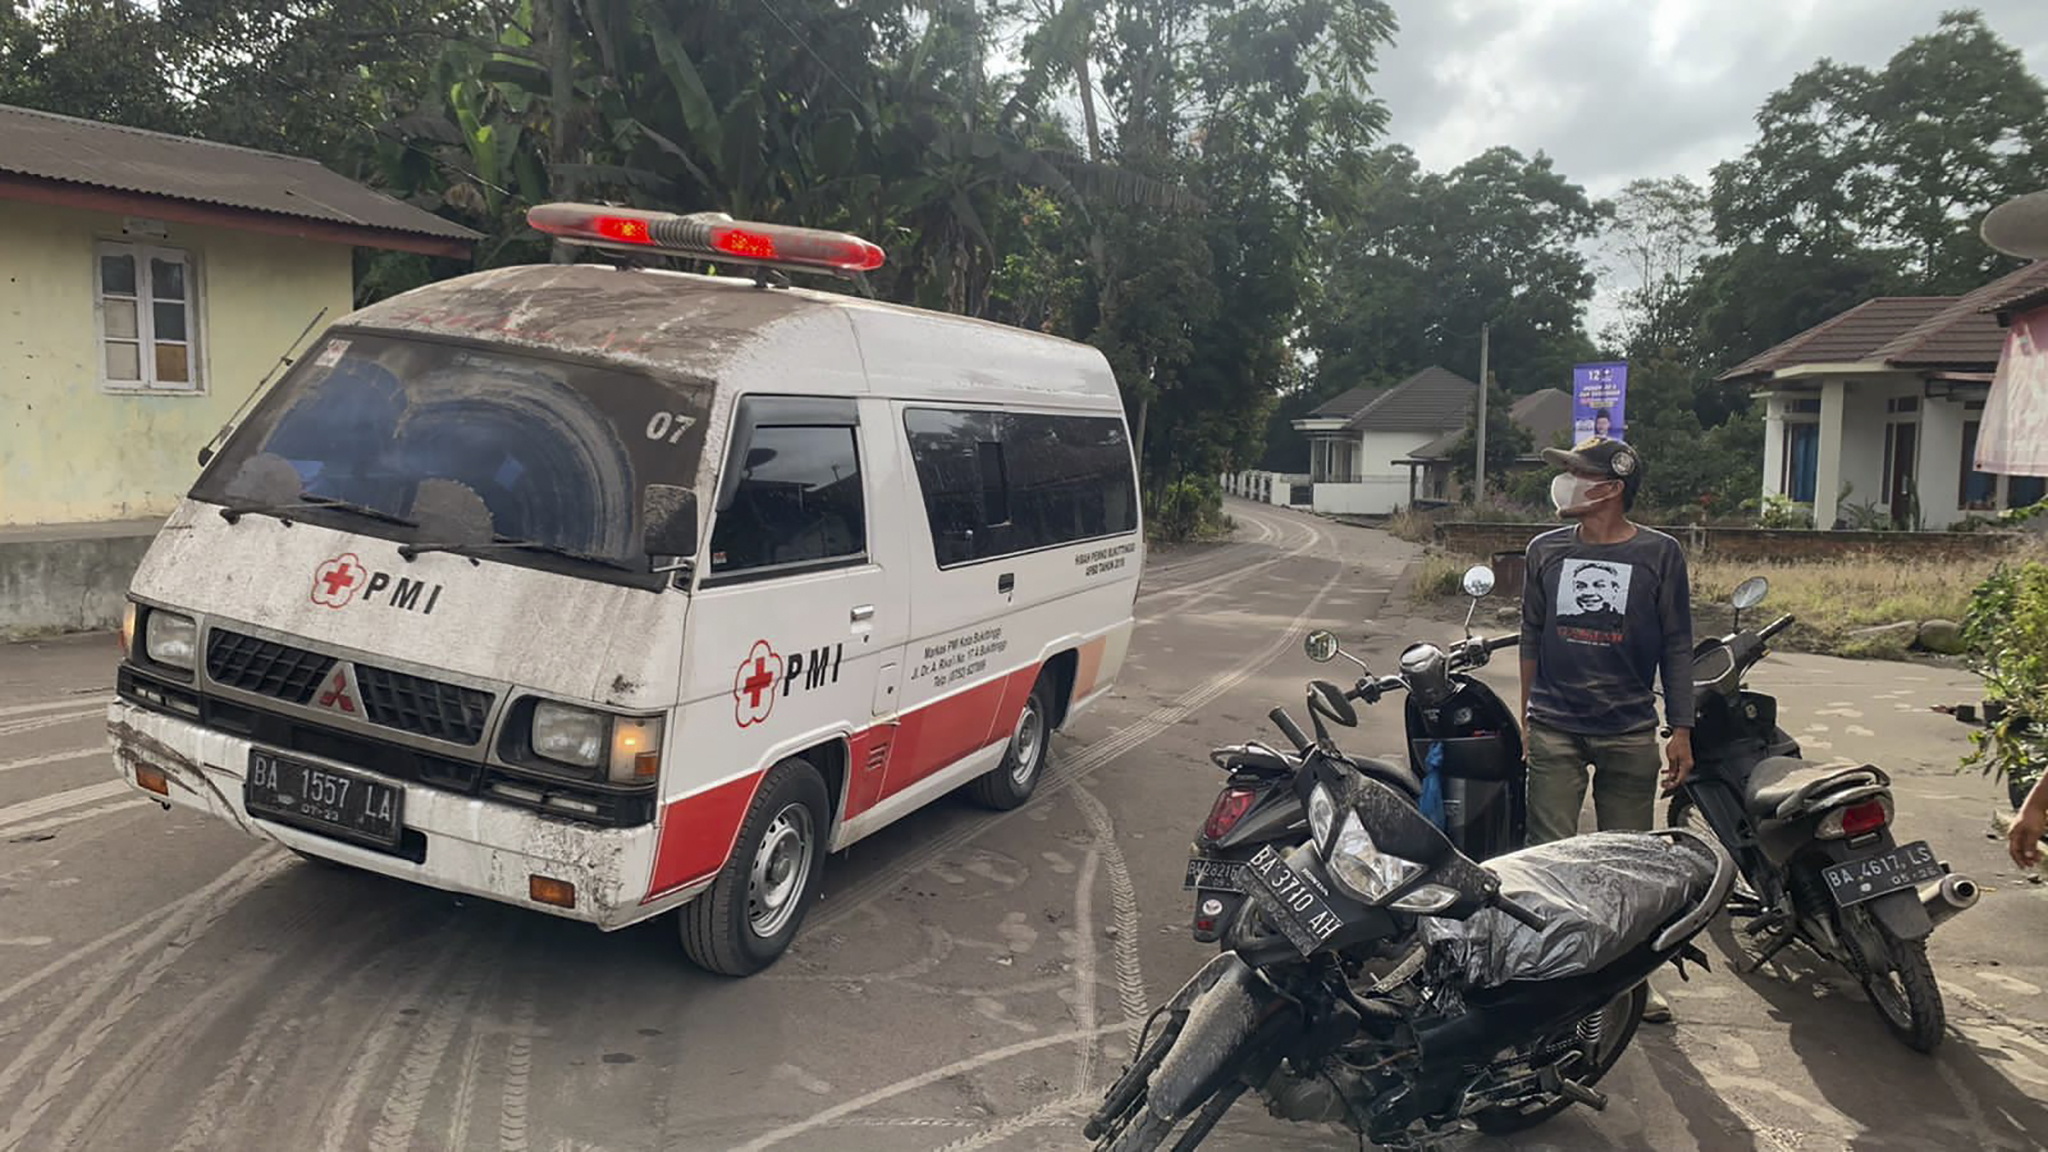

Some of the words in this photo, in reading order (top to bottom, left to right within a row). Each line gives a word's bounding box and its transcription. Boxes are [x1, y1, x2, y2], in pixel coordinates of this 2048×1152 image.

[646, 411, 697, 444] 07
[363, 572, 443, 615] PMI
[783, 643, 843, 697] PMI
[254, 757, 278, 791] BA
[302, 768, 350, 808] 1557
[365, 785, 391, 822] LA
[1828, 869, 1853, 887] BA
[1861, 854, 1900, 877] 4617
[1907, 847, 1932, 865] LS
[1250, 847, 1278, 876] BA
[1271, 869, 1314, 912] 3710
[1308, 911, 1341, 940] AH
